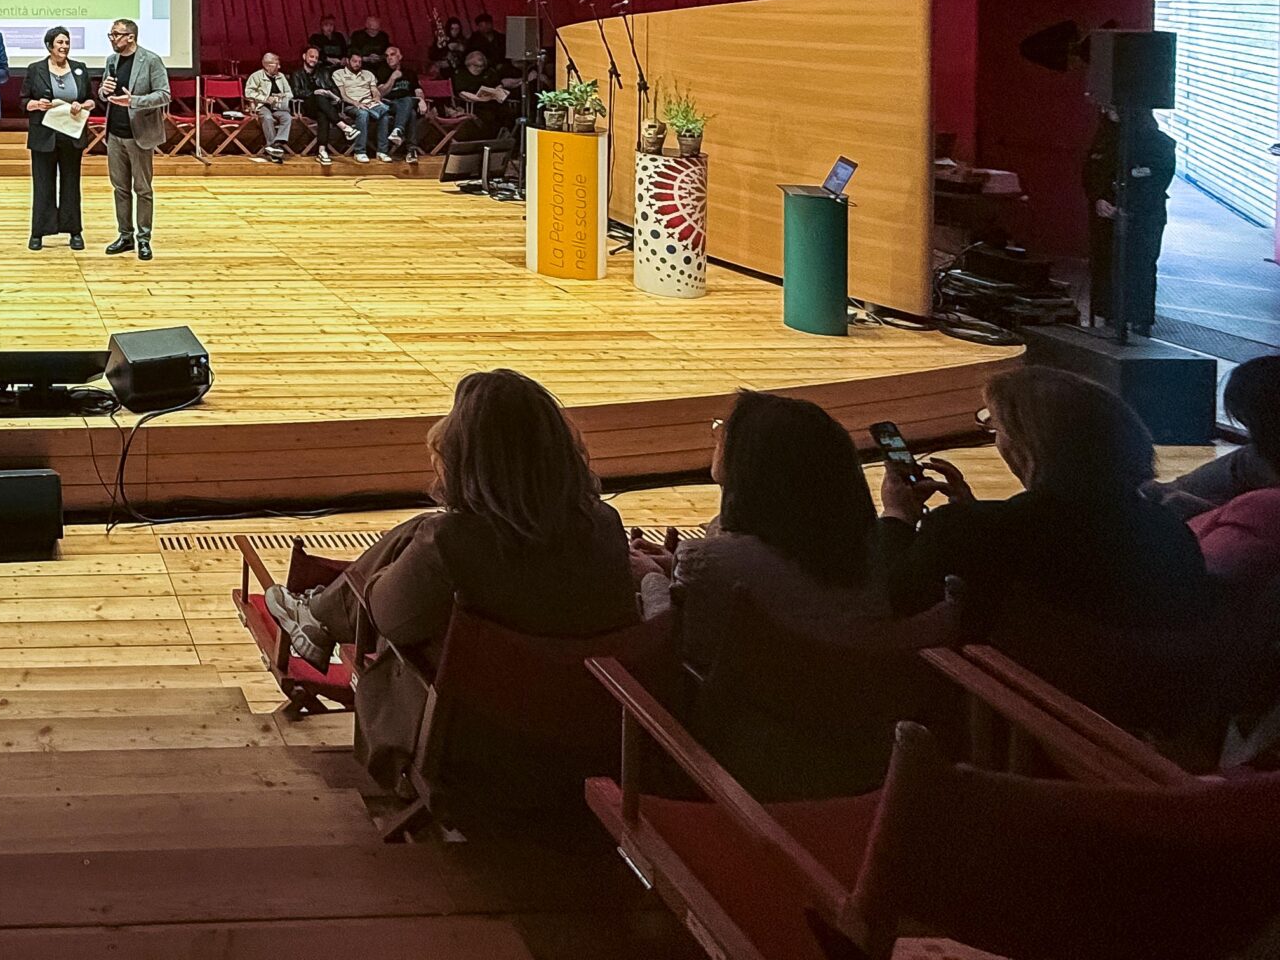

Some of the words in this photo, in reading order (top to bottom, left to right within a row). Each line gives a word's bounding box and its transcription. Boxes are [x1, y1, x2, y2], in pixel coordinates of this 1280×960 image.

[32, 6, 88, 16] universale
[550, 142, 564, 242] Perdonanza
[572, 174, 586, 228] scuole
[550, 248, 564, 268] La
[572, 231, 586, 270] nelle
